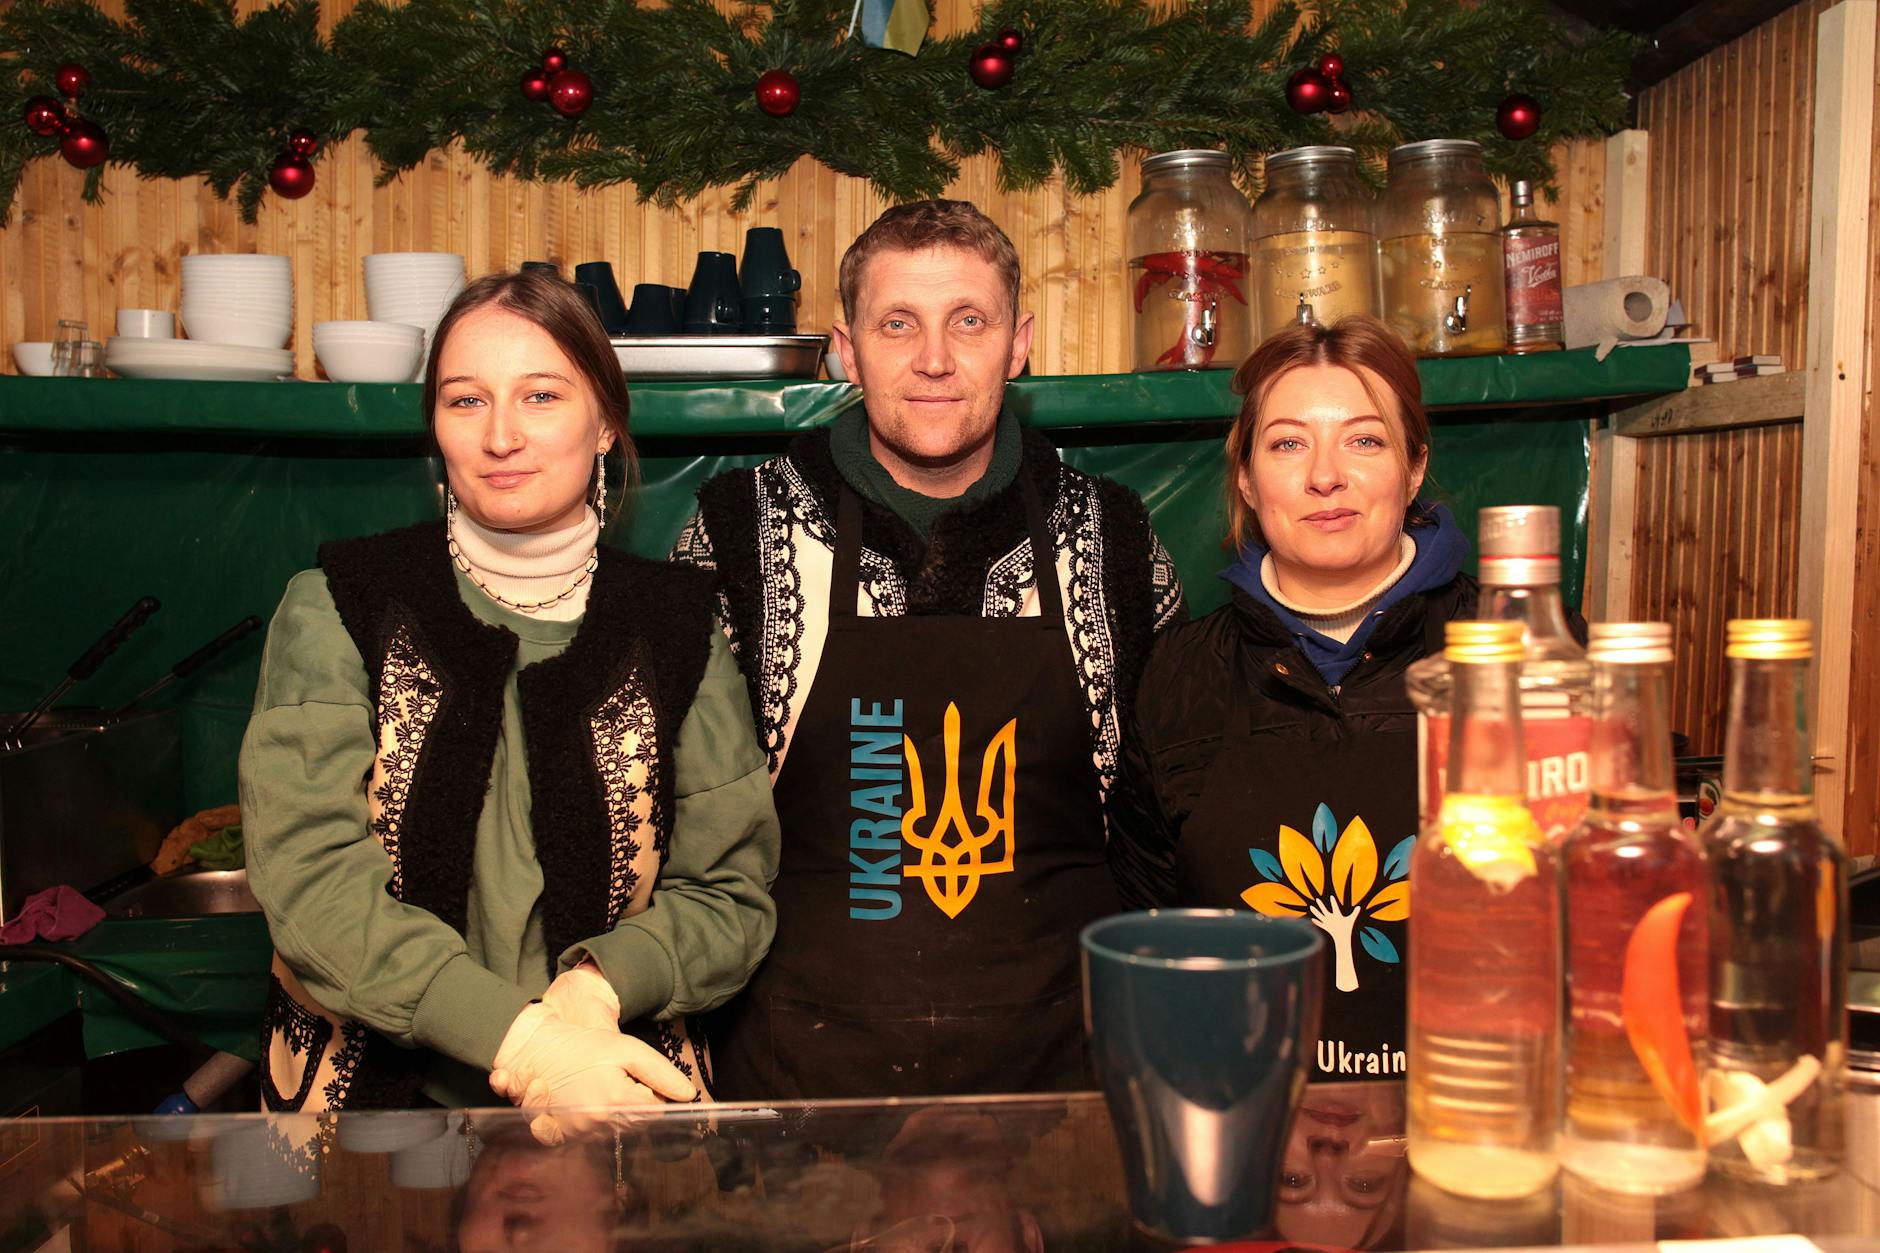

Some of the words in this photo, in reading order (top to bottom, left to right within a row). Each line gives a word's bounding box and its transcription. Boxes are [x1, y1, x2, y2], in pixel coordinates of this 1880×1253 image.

[1506, 242, 1559, 268] NEMIROFF
[849, 698, 904, 921] UKRAINE
[1317, 1039, 1407, 1074] Ukrain
